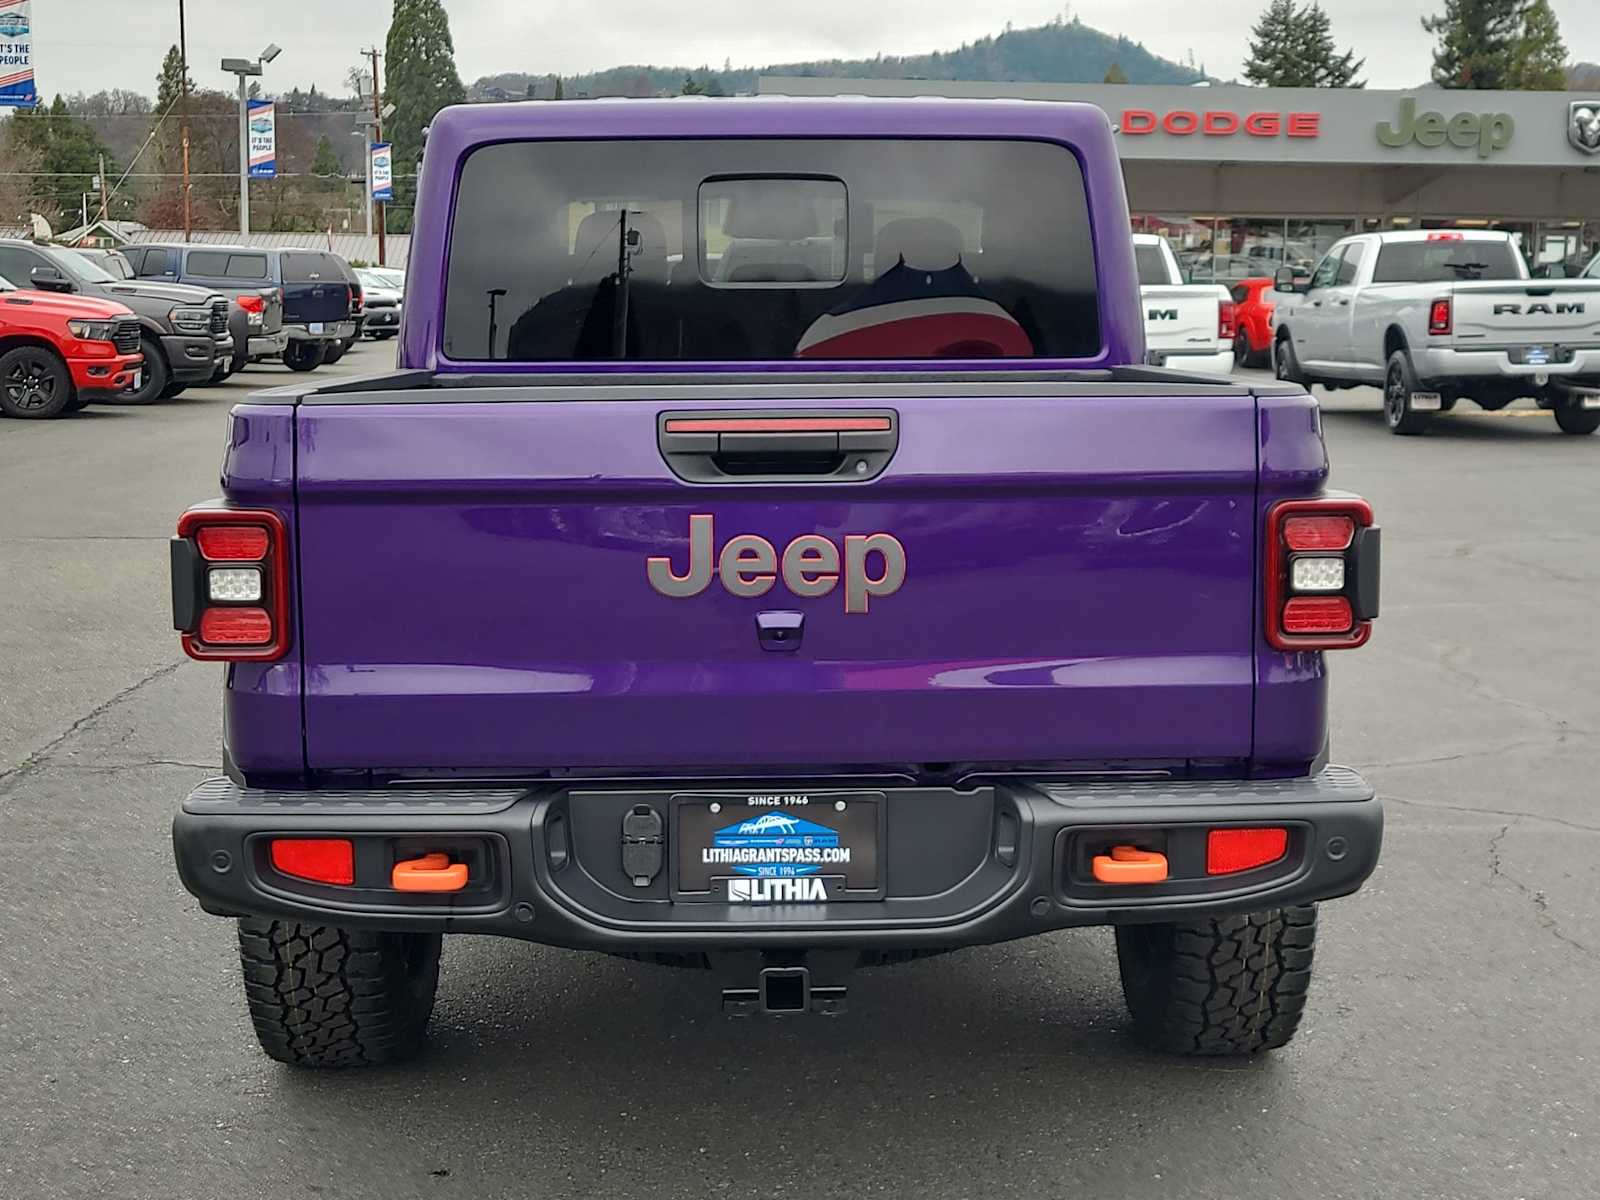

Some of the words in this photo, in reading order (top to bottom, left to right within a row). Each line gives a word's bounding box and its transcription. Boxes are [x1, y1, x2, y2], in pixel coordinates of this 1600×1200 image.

[0, 44, 13, 53] T'S
[15, 44, 30, 53] THE
[0, 56, 30, 65] PEOPLE
[1120, 108, 1321, 137] DODGE
[1376, 97, 1515, 158] Jeep
[1493, 303, 1585, 315] RAM
[646, 513, 907, 614] Jeep
[748, 796, 781, 806] SINCE
[784, 796, 809, 806] 1946
[702, 847, 850, 864] LITHIAGRANTSPASS.COM
[758, 866, 777, 877] SINCE
[751, 878, 828, 901] LITHIA
